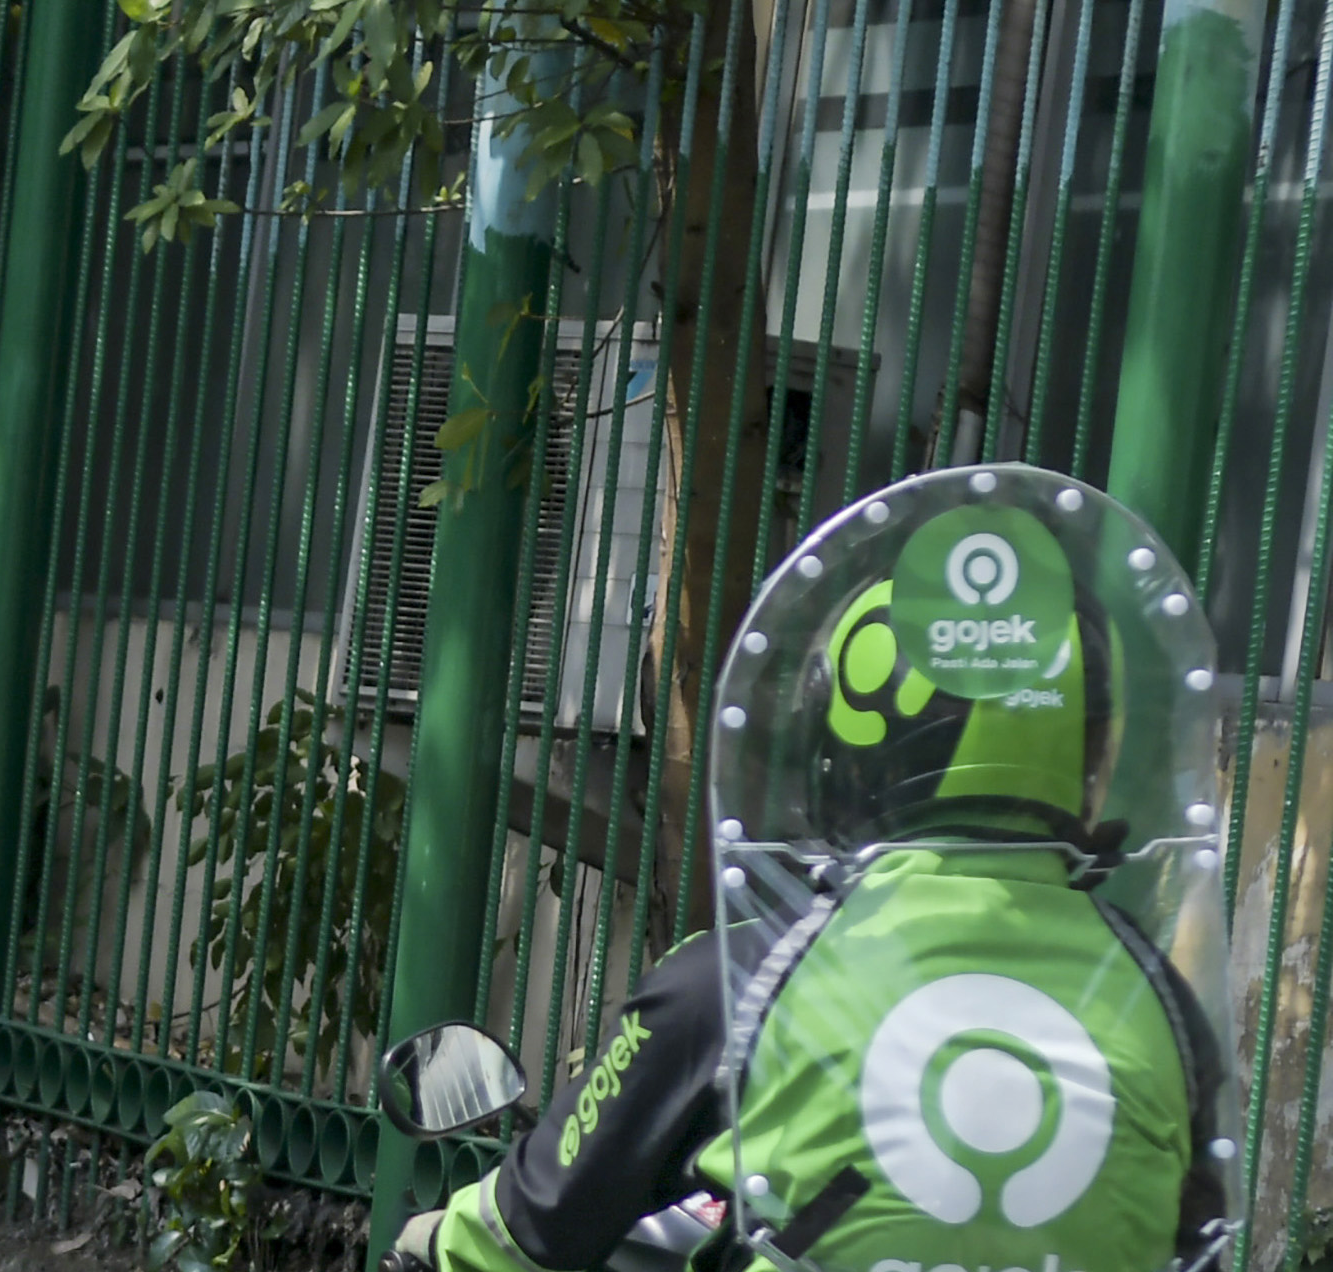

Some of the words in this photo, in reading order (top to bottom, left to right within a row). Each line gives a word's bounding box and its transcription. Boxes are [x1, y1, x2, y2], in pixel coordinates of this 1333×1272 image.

[928, 614, 1037, 652] gojek
[1004, 688, 1064, 708] gojek
[578, 1008, 653, 1134] gojek
